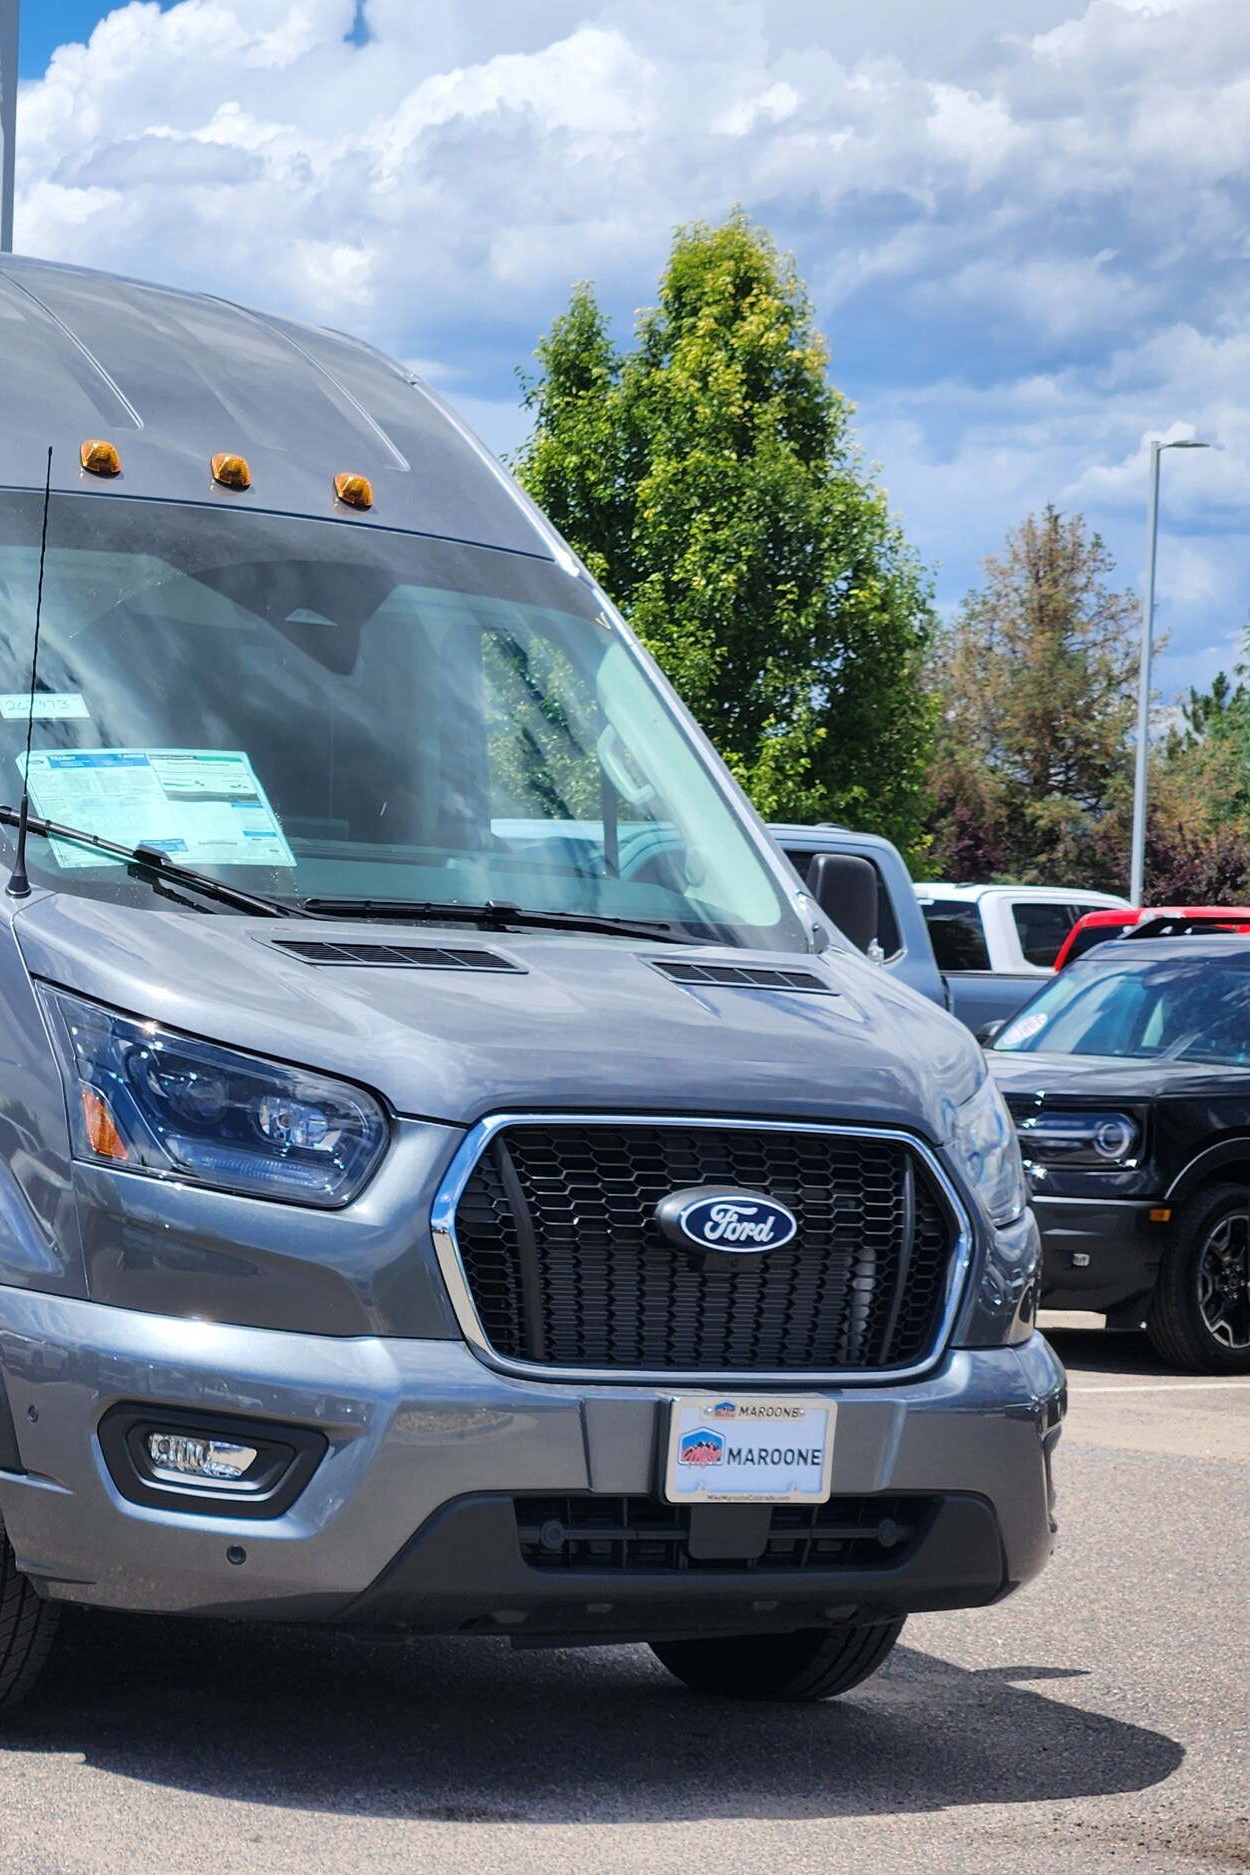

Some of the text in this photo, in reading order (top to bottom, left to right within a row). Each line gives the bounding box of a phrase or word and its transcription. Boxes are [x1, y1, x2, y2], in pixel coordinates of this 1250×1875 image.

[703, 1203, 777, 1242] Ford
[738, 1406, 800, 1418] MAROONE
[726, 1447, 823, 1466] MAROONE
